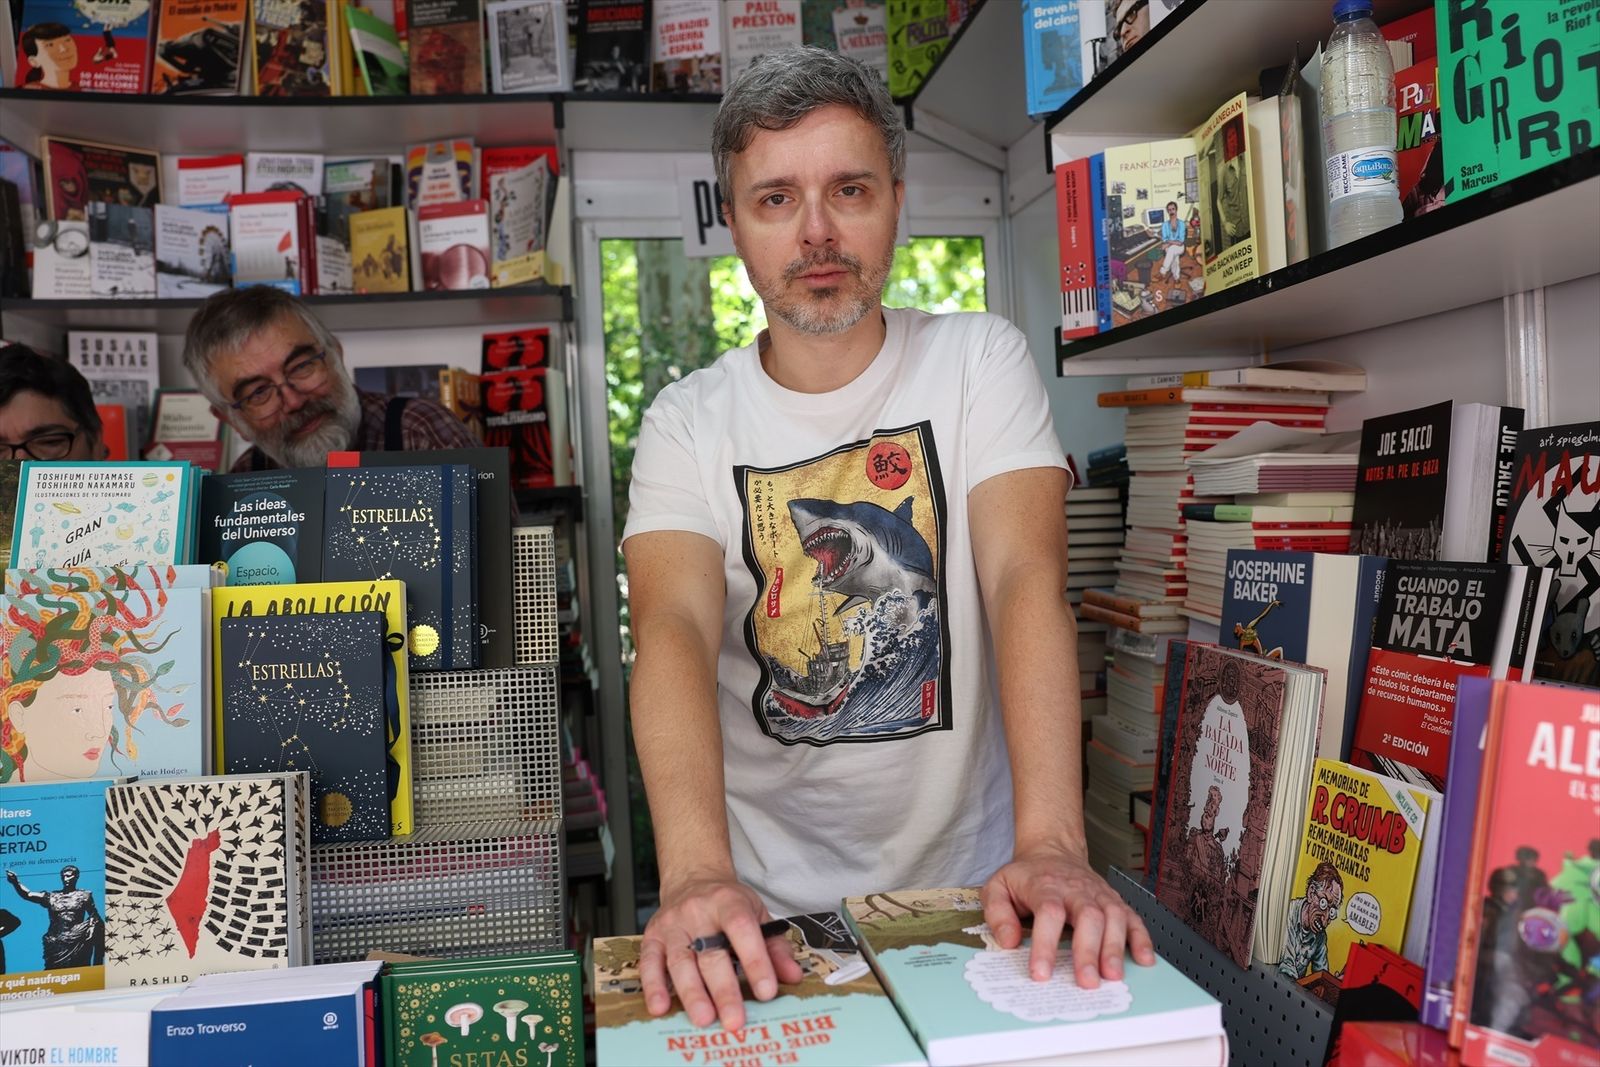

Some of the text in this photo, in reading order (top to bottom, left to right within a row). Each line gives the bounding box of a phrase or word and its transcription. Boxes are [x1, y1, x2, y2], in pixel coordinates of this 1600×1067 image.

[745, 1, 781, 14] PAUL
[1034, 4, 1068, 18] Breve
[1548, 11, 1559, 24] la
[732, 12, 797, 29] PRESTON
[1034, 14, 1078, 29] del cine
[1566, 13, 1591, 33] Riot
[1212, 99, 1243, 128] LANEGAN
[1119, 157, 1181, 173] FRANK ZAPPA
[1460, 162, 1484, 179] Sara
[1461, 171, 1499, 192] Marcus
[1217, 244, 1253, 270] BACKWARDS
[1223, 266, 1233, 279] AND
[1234, 257, 1254, 273] WEEP
[79, 338, 148, 351] SUSAN
[80, 353, 149, 367] SONTAG
[162, 412, 193, 422] Walter
[161, 422, 205, 433] Benjamin
[1377, 424, 1433, 457] JOE SACCO
[1540, 433, 1555, 448] art
[37, 473, 134, 481] TOSHIFUMI FUTAMASE
[1365, 458, 1439, 482] NOTAS AL PIE DE GAZA
[87, 481, 136, 489] NAKAMARU
[233, 498, 287, 513] Las ideas
[352, 507, 428, 524] ESTRELLAS
[214, 510, 305, 527] fundamentales
[65, 517, 103, 545] GRAN
[221, 526, 296, 540] del Universo
[62, 548, 92, 569] GUÍA
[236, 565, 280, 579] Espacio,
[1228, 559, 1306, 585] JOSEPHINE
[1233, 580, 1278, 603] BAKER
[1374, 569, 1382, 603] BOCQUET
[1397, 576, 1460, 596] CUANDO
[1465, 580, 1486, 598] EL
[228, 584, 391, 618] LA ABOLICIÓN
[1395, 594, 1482, 620] TRABAJO
[1388, 614, 1473, 657] MATA
[252, 661, 334, 681] ESTRELLAS
[1372, 665, 1390, 676] «Este
[1391, 669, 1411, 681] cómic
[1413, 673, 1441, 688] debería
[1369, 676, 1378, 684] en
[1378, 678, 1398, 689] todos
[1399, 682, 1409, 692] los
[1367, 686, 1446, 712] de recursos humanos.»
[1219, 715, 1231, 733] LA
[1420, 721, 1427, 729] El
[1423, 712, 1439, 722] Paula
[1204, 724, 1243, 754] BALADA
[1392, 736, 1429, 757] EDICIÓN
[1212, 742, 1231, 764] DEL
[141, 767, 188, 776] Kate Hodges
[1204, 754, 1237, 782] NORTE
[1318, 767, 1371, 799] MEMORIAS DE
[1395, 790, 1418, 825] INCLUYE CD
[1312, 785, 1408, 854] R. CRUMB
[1308, 824, 1370, 863] REMEMBRANZAS
[37, 857, 77, 865] democracia
[1305, 840, 1371, 883] Y OTRAS CHANZAS
[1350, 912, 1377, 932] AMABLE!
[5, 972, 81, 990] qué naufragan
[130, 974, 190, 987] RASHID
[166, 1022, 247, 1037] Enzo Traverso
[782, 1014, 837, 1037] BIN
[666, 1023, 772, 1051] LADEN
[0, 1046, 118, 1066] VIKTOR EL HOMBRE
[450, 1048, 528, 1067] SETAS
[682, 1033, 832, 1065] QUE CONOCÍ A
[768, 1050, 799, 1065] EL
